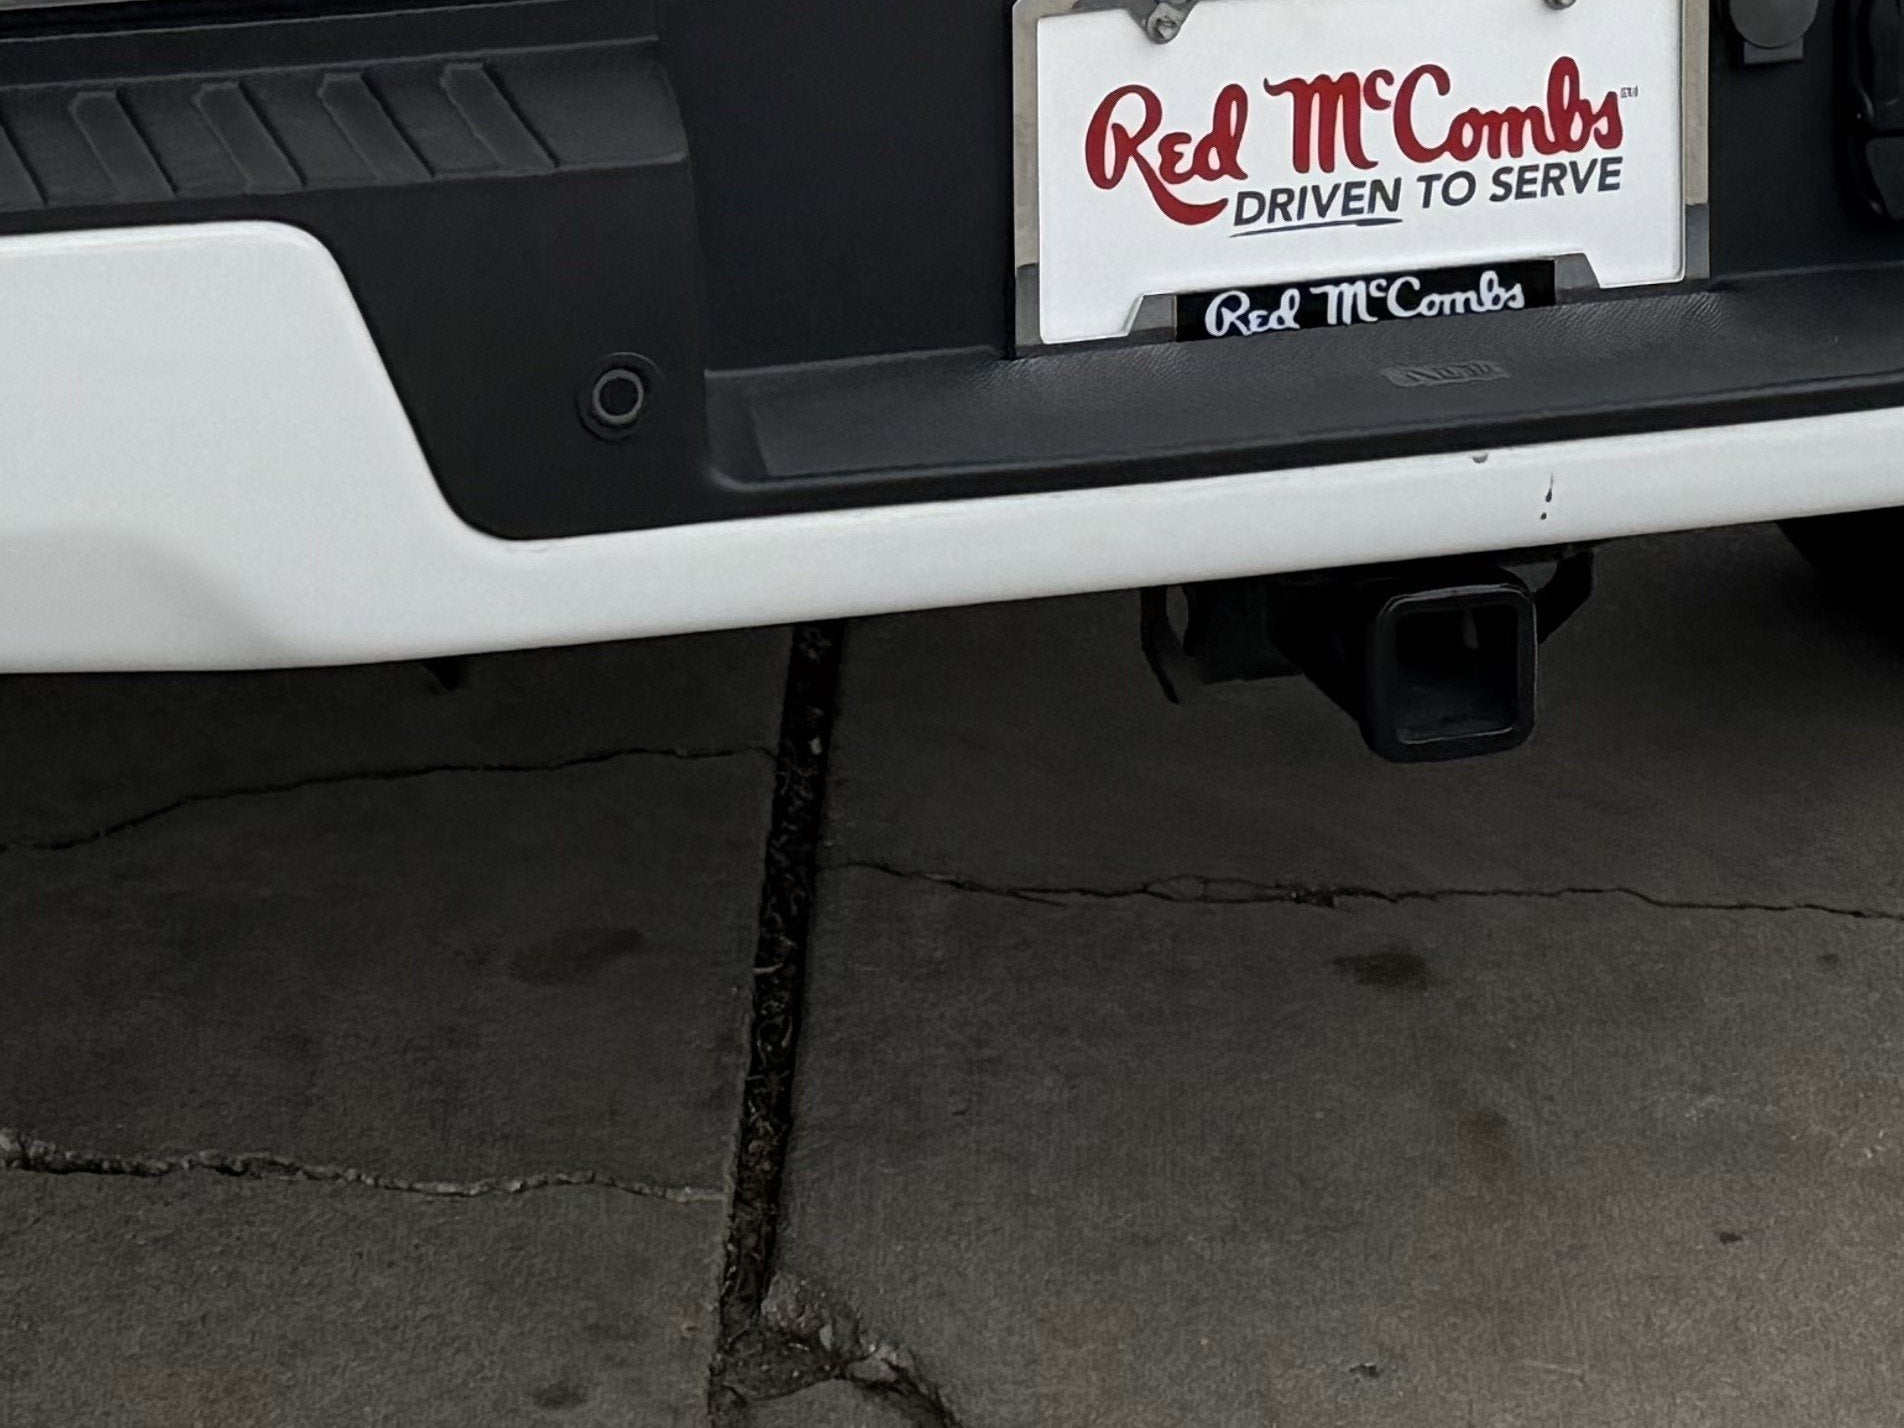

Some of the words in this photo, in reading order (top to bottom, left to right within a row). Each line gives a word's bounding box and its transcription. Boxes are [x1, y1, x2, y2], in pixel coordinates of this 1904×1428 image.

[1085, 83, 1248, 226] Red
[1264, 57, 1623, 173] McCombs
[1234, 177, 1402, 228] DRIVEN
[1417, 171, 1477, 210] TO
[1490, 156, 1623, 203] SERVE
[1205, 288, 1300, 336] Red
[1309, 270, 1525, 325] McCombs
